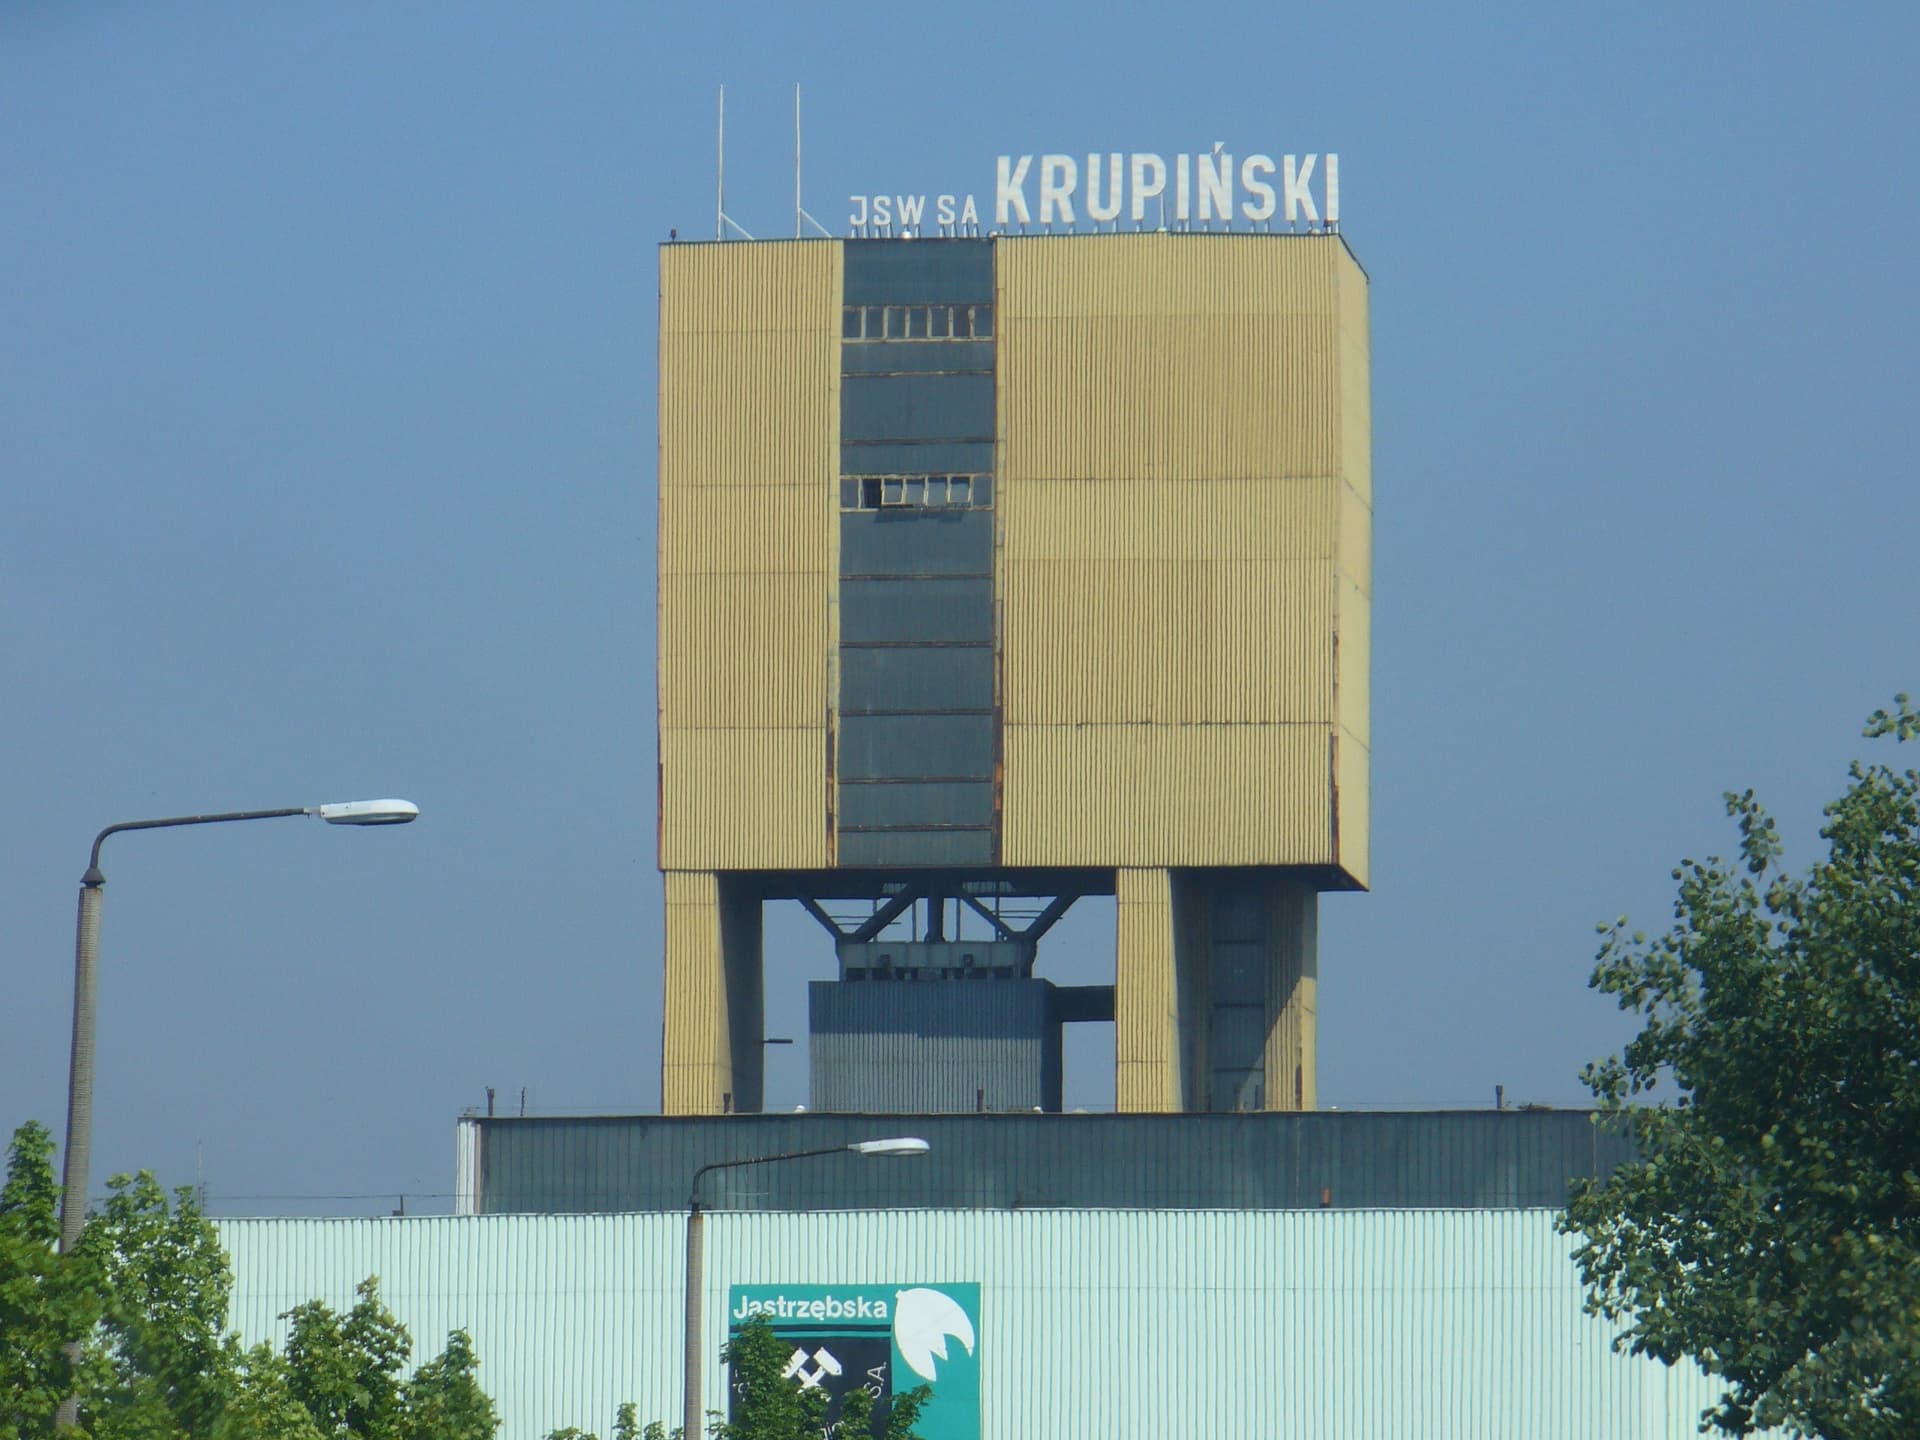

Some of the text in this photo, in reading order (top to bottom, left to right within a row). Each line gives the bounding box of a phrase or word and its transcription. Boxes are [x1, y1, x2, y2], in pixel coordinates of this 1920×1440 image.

[849, 141, 1339, 225] JSW SA KRUPIŃSKI
[733, 1295, 888, 1321] Jastrzębska
